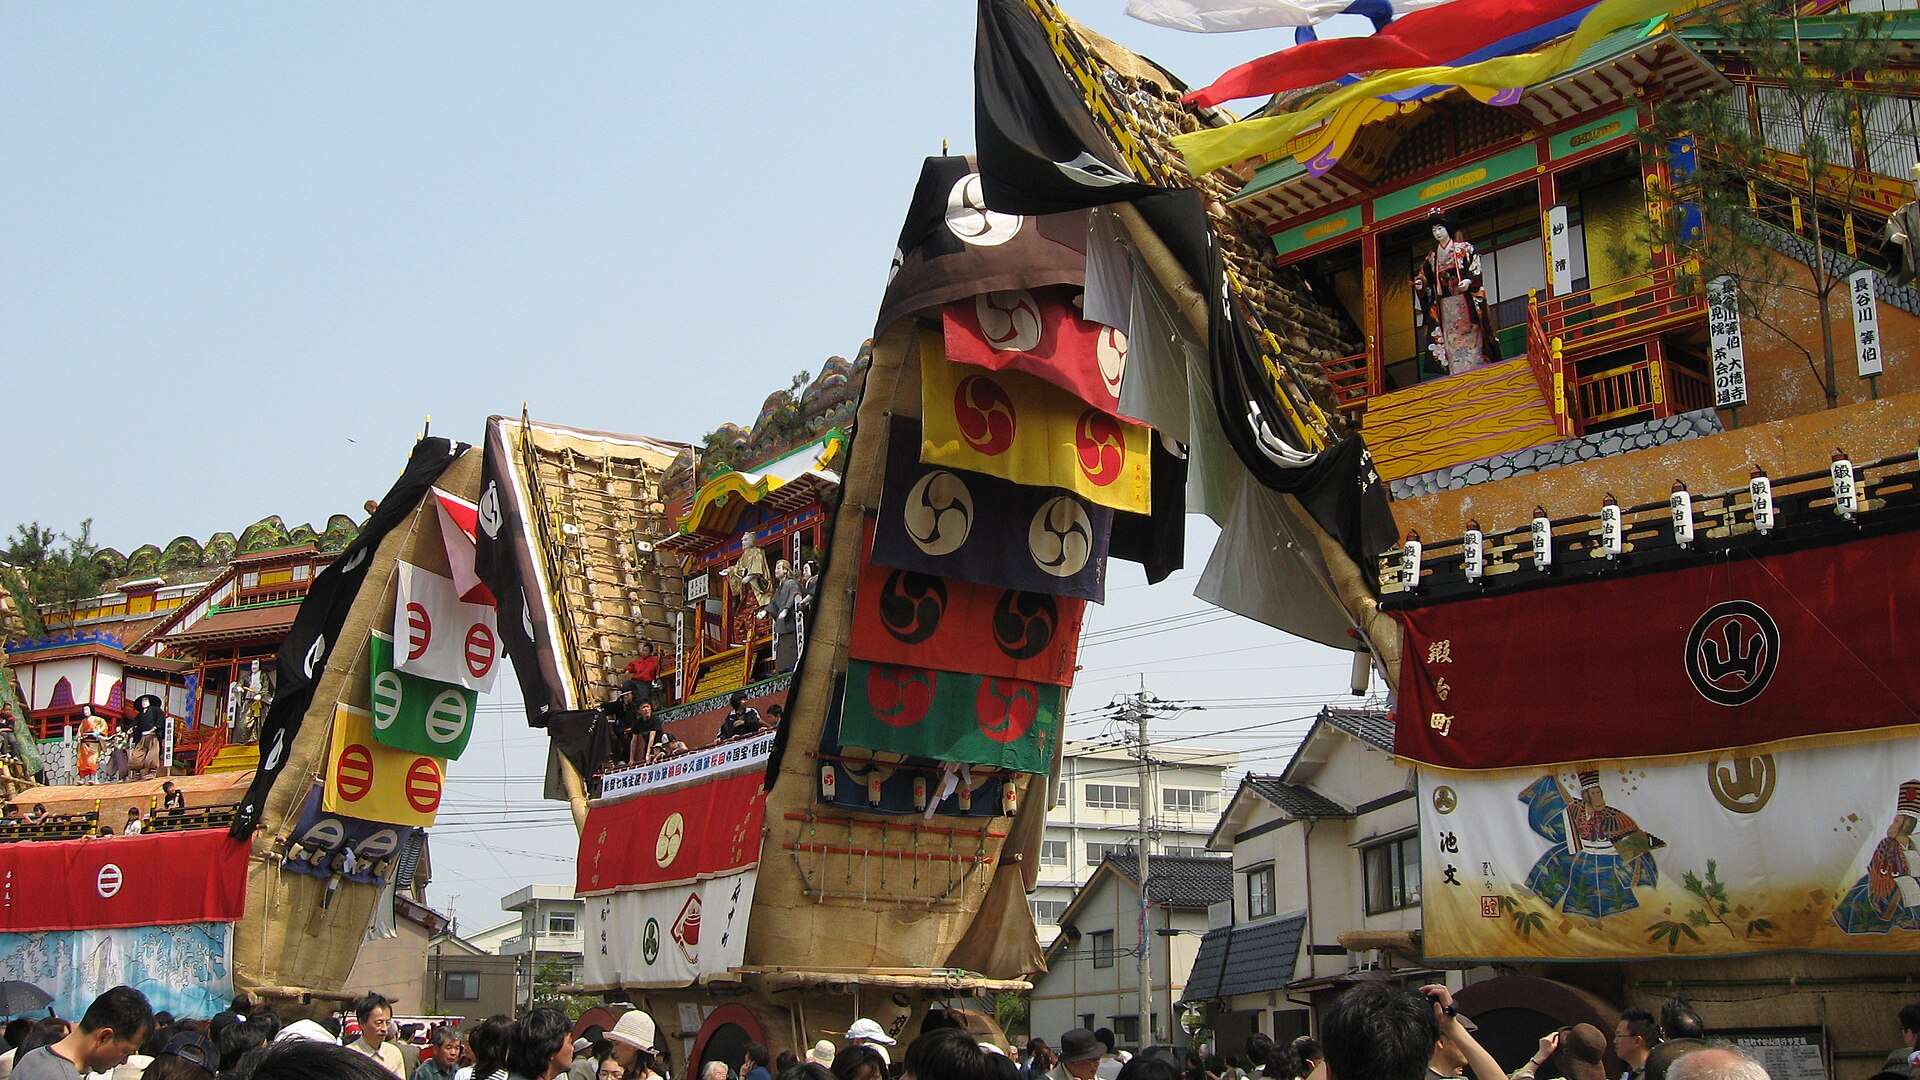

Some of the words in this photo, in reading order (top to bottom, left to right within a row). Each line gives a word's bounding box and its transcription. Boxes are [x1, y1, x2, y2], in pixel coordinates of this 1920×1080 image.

[1854, 277, 1873, 323] 長谷川
[1859, 330, 1878, 362] 等伯
[1714, 347, 1731, 404] 茶会の場
[1728, 357, 1744, 400] 大徳寺
